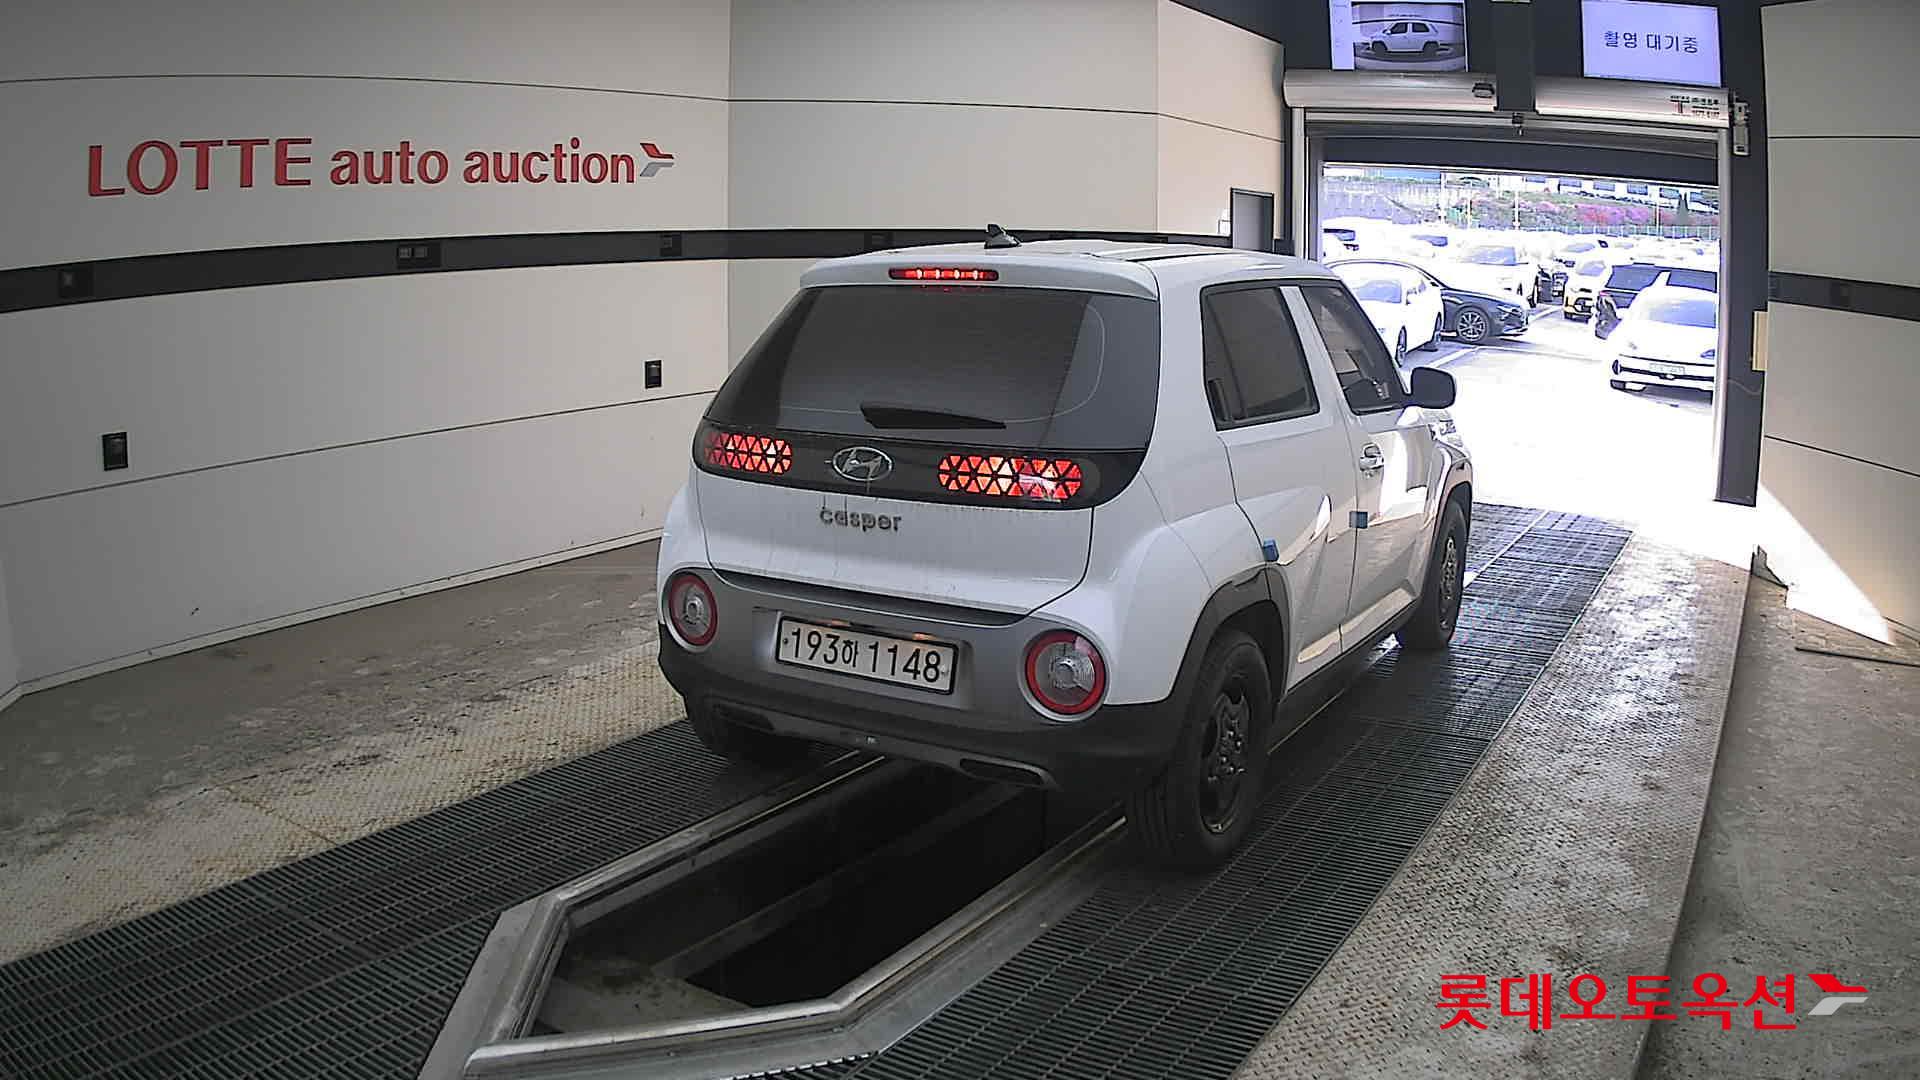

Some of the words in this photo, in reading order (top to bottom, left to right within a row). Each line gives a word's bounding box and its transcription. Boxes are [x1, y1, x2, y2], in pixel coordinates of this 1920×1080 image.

[1646, 33, 1698, 53] 대기중
[88, 138, 312, 197] LOTTE
[330, 141, 450, 185] auto
[463, 136, 636, 184] auction
[819, 509, 902, 533] casper
[868, 640, 941, 683] 1148
